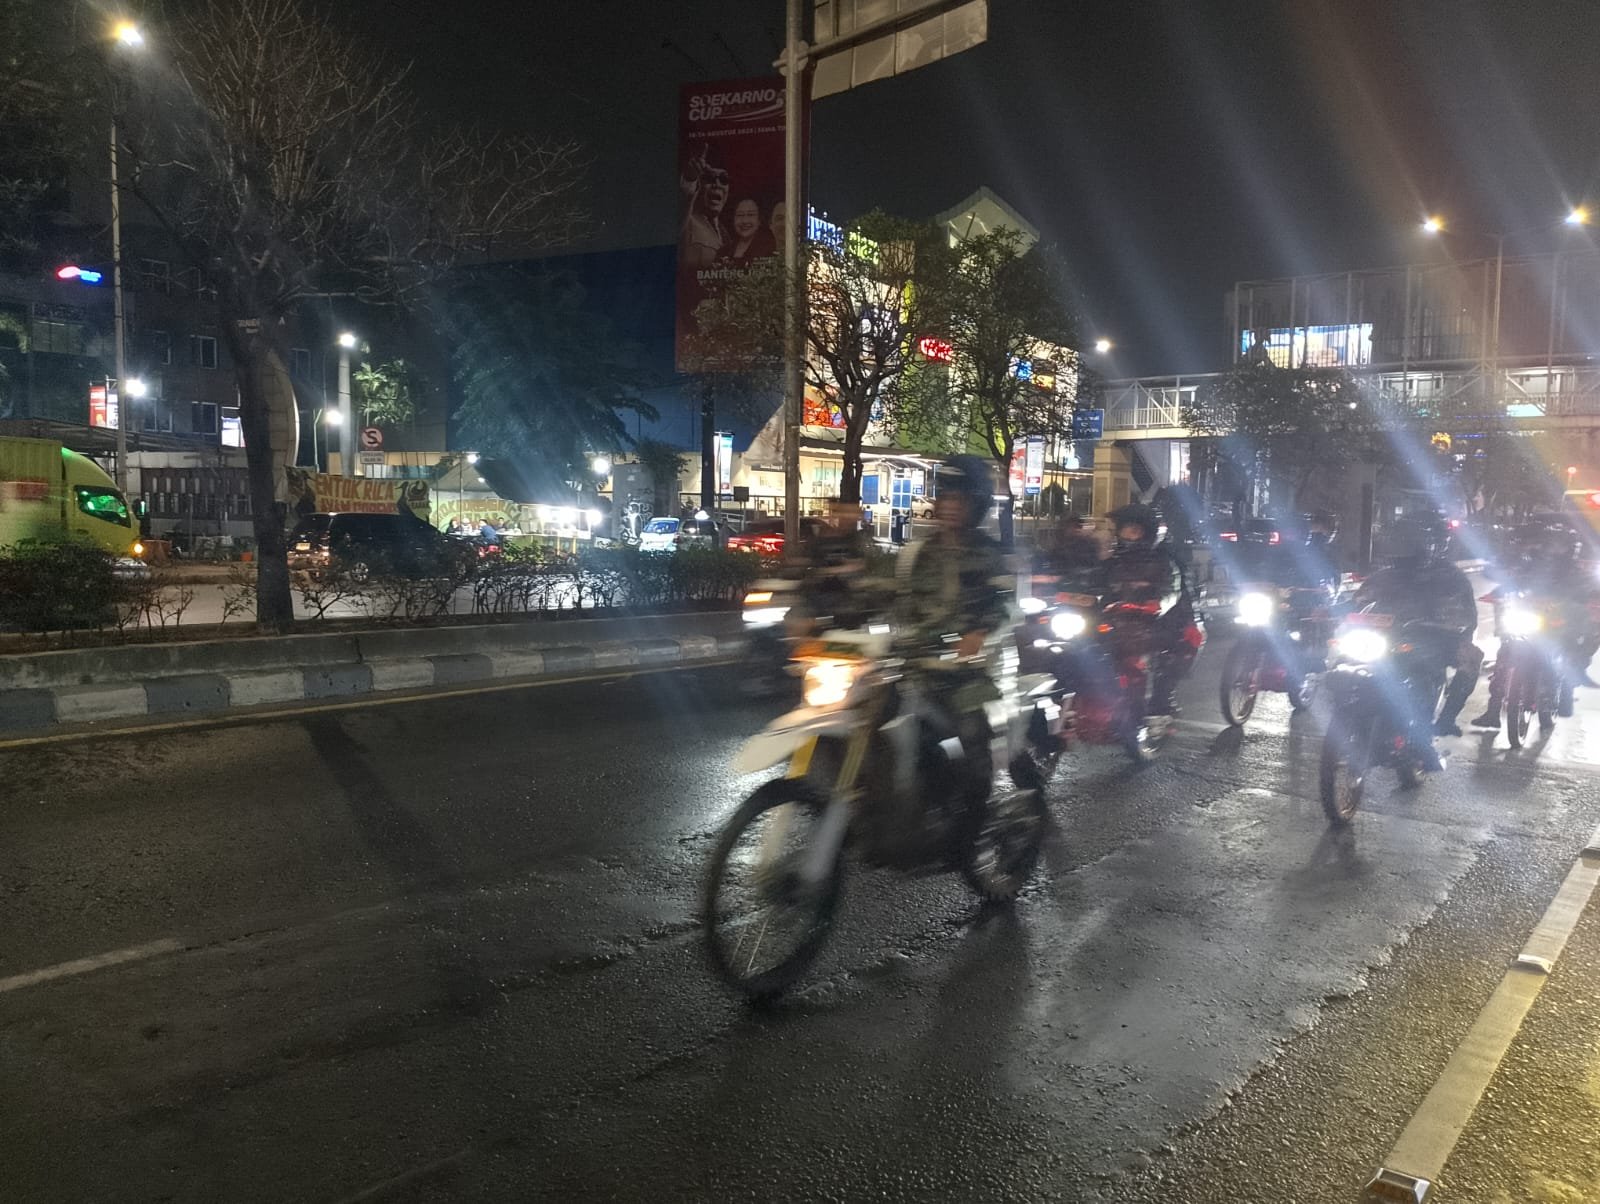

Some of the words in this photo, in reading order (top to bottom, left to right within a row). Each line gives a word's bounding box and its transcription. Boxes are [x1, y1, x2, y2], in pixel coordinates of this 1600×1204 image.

[688, 106, 722, 121] CUP
[696, 269, 744, 280] BANTENG
[367, 430, 378, 444] S
[316, 475, 360, 499] ENTOK
